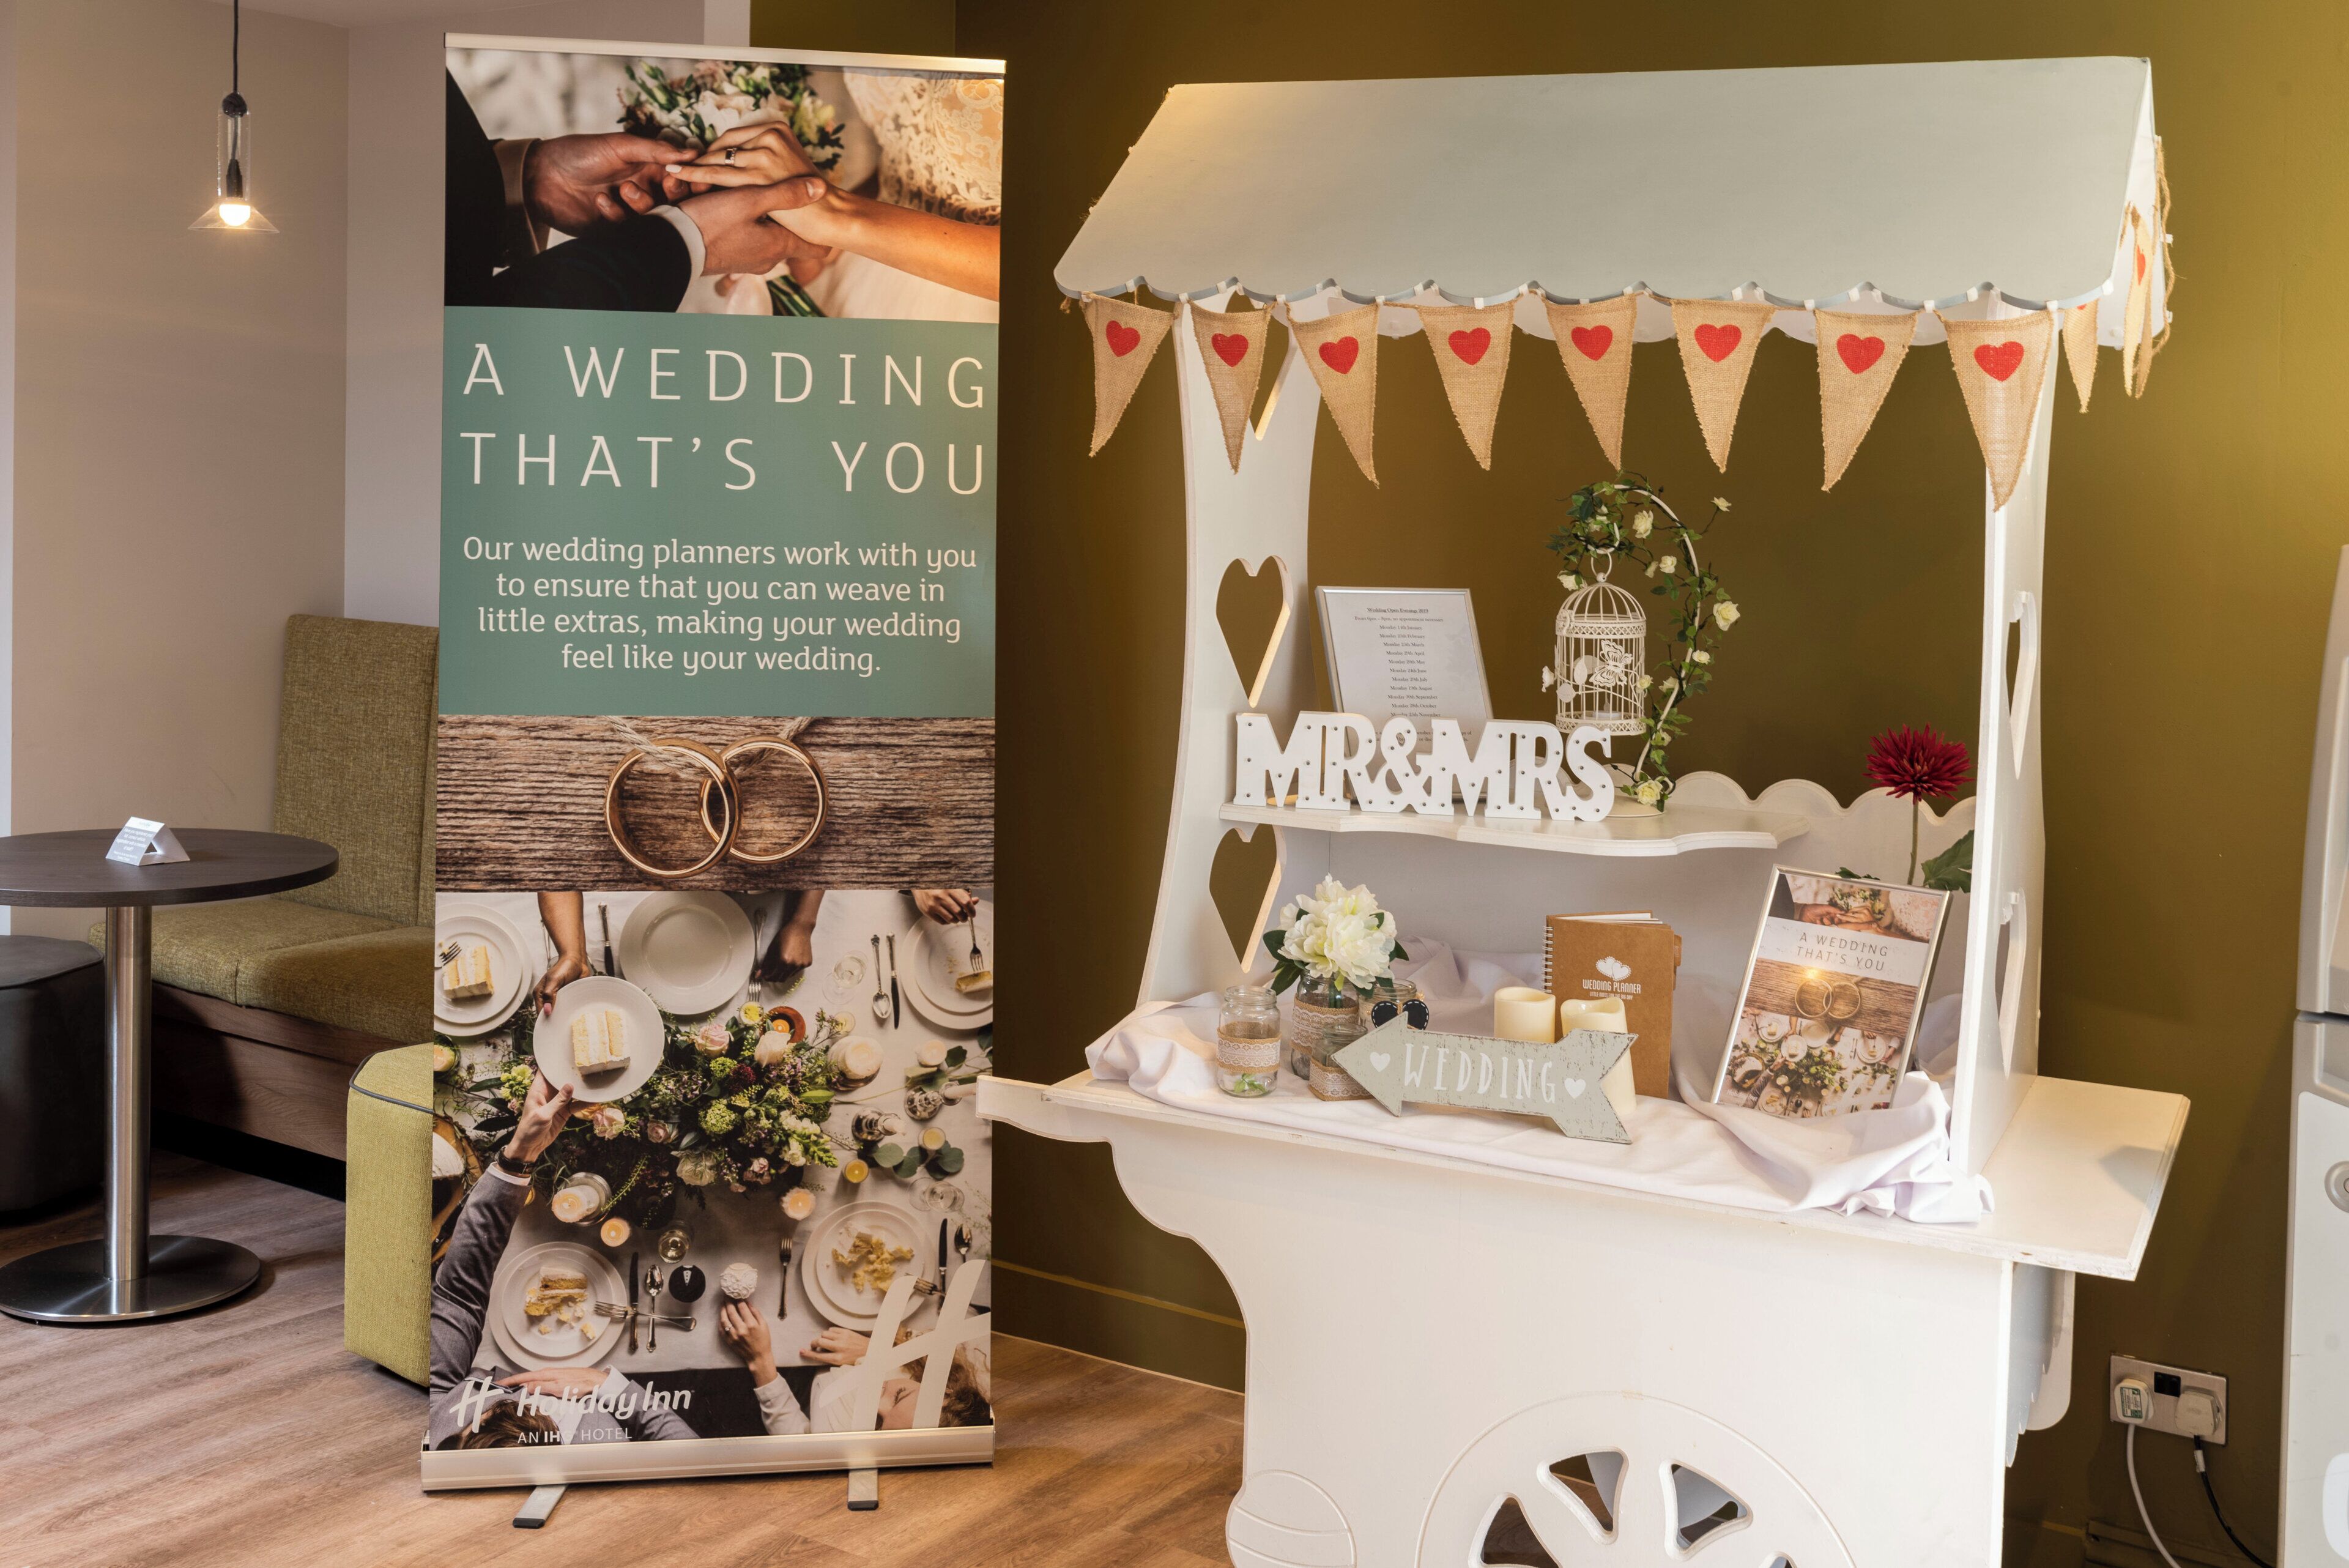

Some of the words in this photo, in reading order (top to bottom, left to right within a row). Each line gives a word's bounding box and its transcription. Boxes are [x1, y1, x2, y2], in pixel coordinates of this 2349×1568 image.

[462, 343, 505, 396] A
[562, 344, 987, 411] WEDDING
[830, 440, 984, 496] YOU
[463, 537, 514, 561] Our
[522, 537, 644, 570] wedding
[653, 538, 776, 570] planners
[784, 540, 851, 566] work
[858, 541, 918, 567] with
[926, 548, 979, 574] you
[496, 572, 525, 597] to
[533, 578, 630, 598] ensure
[637, 575, 698, 600] that
[706, 581, 760, 606] you
[766, 581, 816, 601] can
[825, 582, 911, 602] weave
[919, 578, 945, 603] in
[477, 606, 546, 633] little
[554, 610, 648, 637] extras,
[656, 611, 763, 642] making
[773, 617, 837, 642] your
[843, 614, 961, 644] wedding
[560, 643, 615, 669] feel
[622, 644, 674, 670] like
[683, 651, 748, 677] your
[754, 645, 881, 678] wedding.
[1797, 946, 1847, 964] THAT'S
[1856, 956, 1885, 972] YOU
[1799, 932, 1807, 943] A
[1817, 934, 1888, 957] WEDDING
[1583, 978, 1612, 991] WEDDING
[1613, 981, 1641, 994] PLANNER
[1405, 1043, 1556, 1104] WEDDING
[516, 1384, 638, 1420] Holiday
[642, 1381, 692, 1411] Inn
[517, 1432, 539, 1444] AN
[581, 1427, 633, 1441] HOTEL
